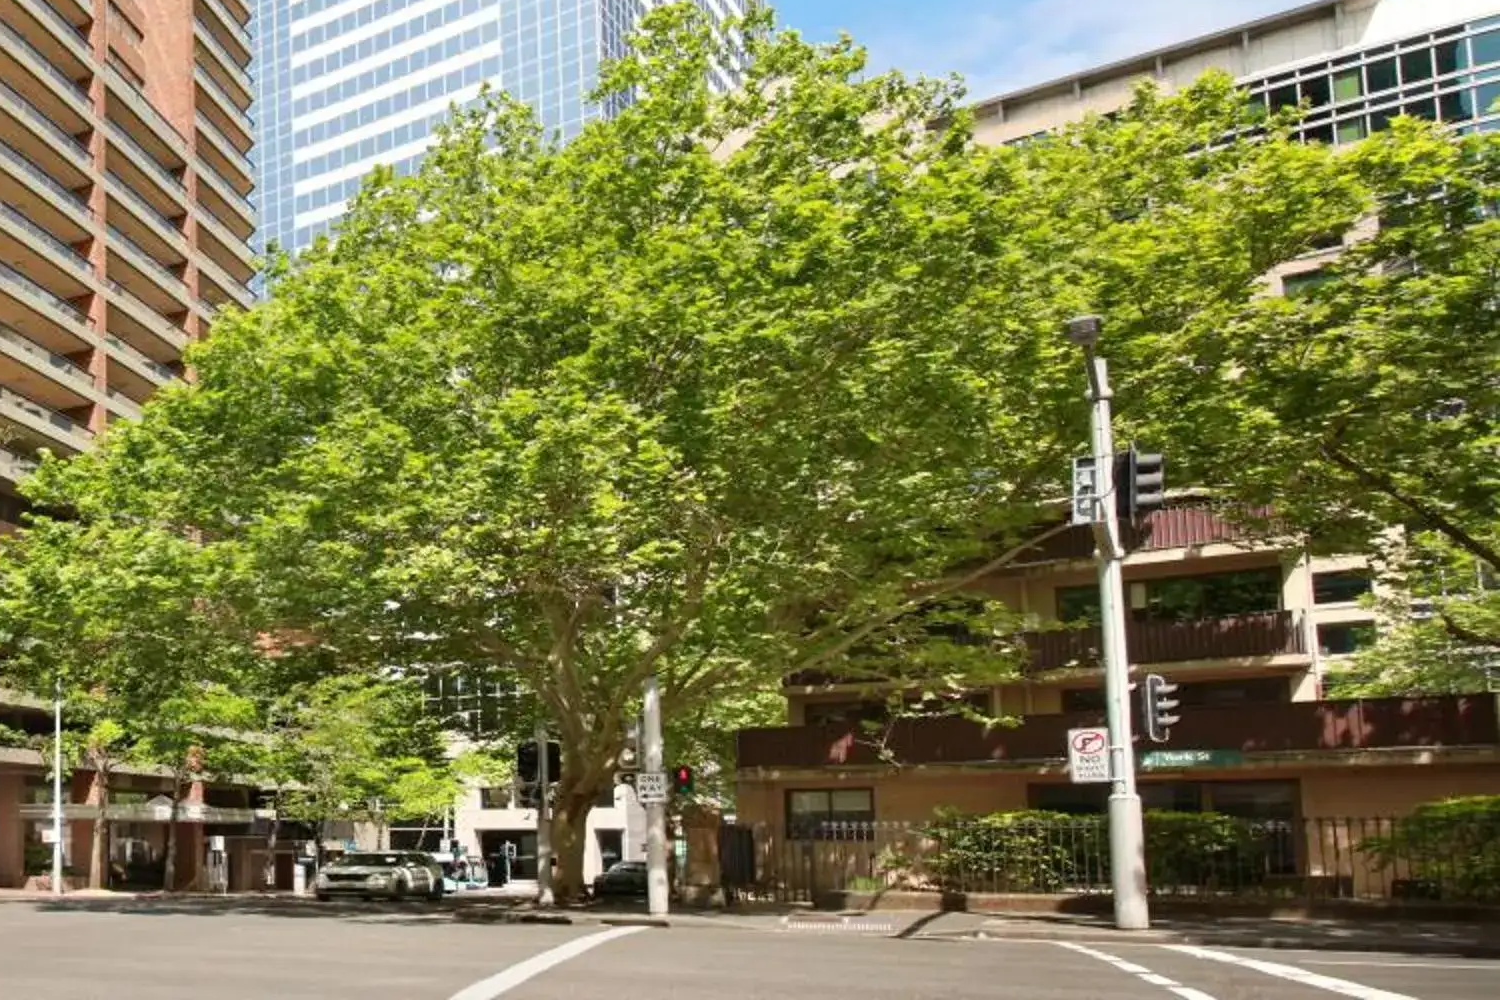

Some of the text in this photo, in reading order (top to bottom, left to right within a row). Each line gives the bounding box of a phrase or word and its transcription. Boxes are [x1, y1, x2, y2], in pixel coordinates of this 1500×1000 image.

[1078, 754, 1101, 763] NO
[1163, 750, 1211, 761] York St
[639, 775, 660, 783] ONE
[638, 784, 662, 792] WAY
